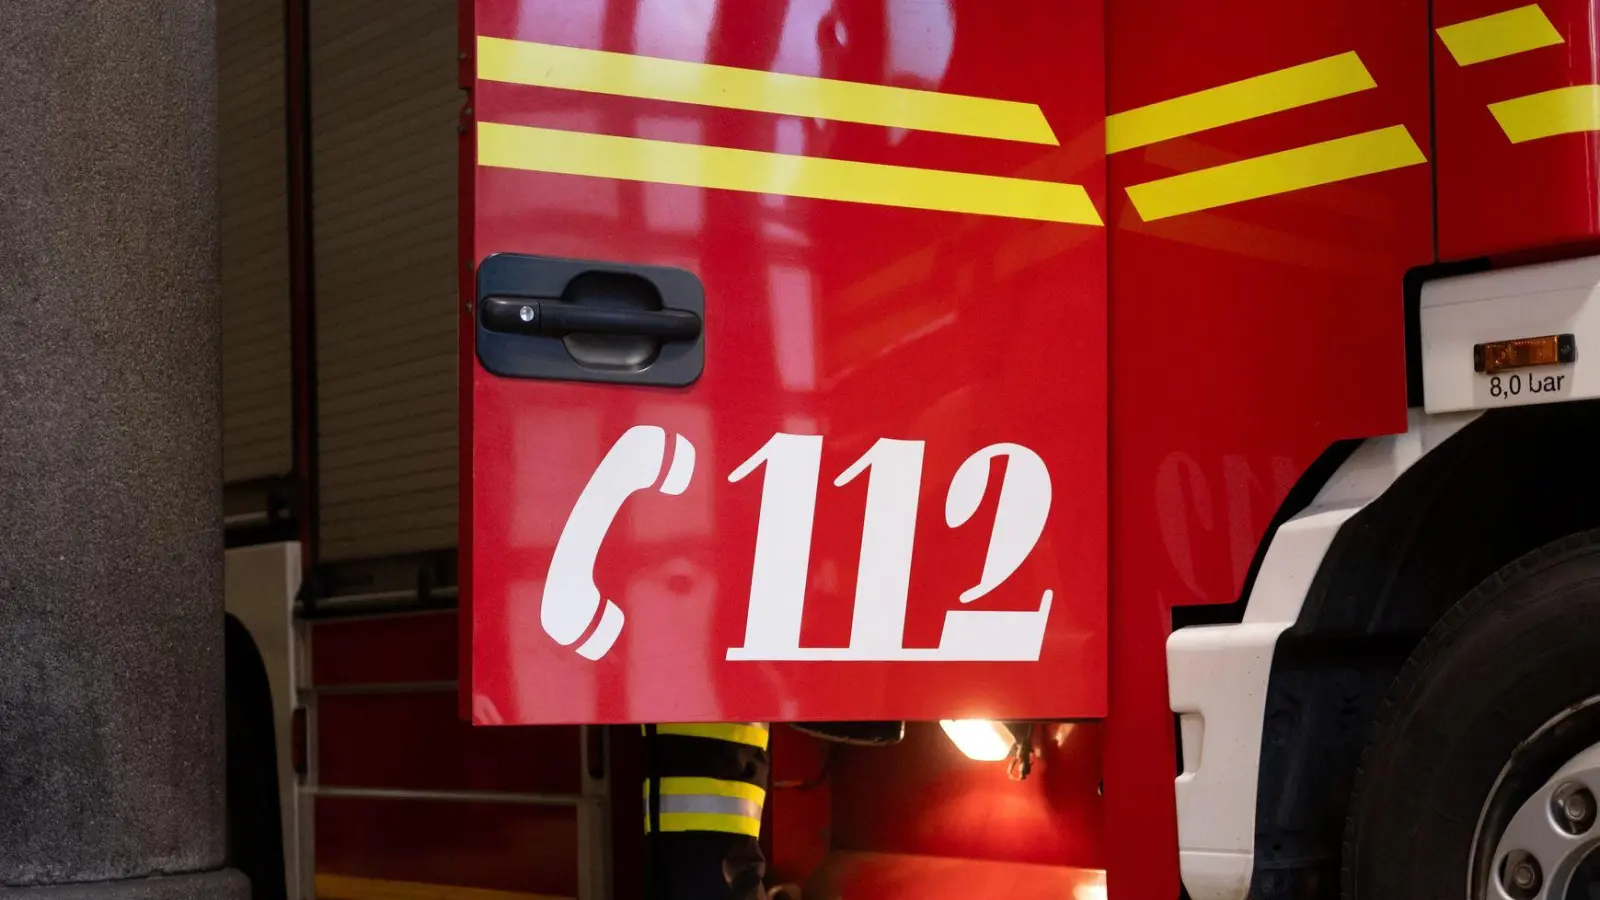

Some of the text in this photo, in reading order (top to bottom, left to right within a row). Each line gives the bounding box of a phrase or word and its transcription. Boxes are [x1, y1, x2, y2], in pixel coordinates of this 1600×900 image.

[1490, 373, 1565, 399] 8,0 bar
[726, 433, 1053, 661] 112
